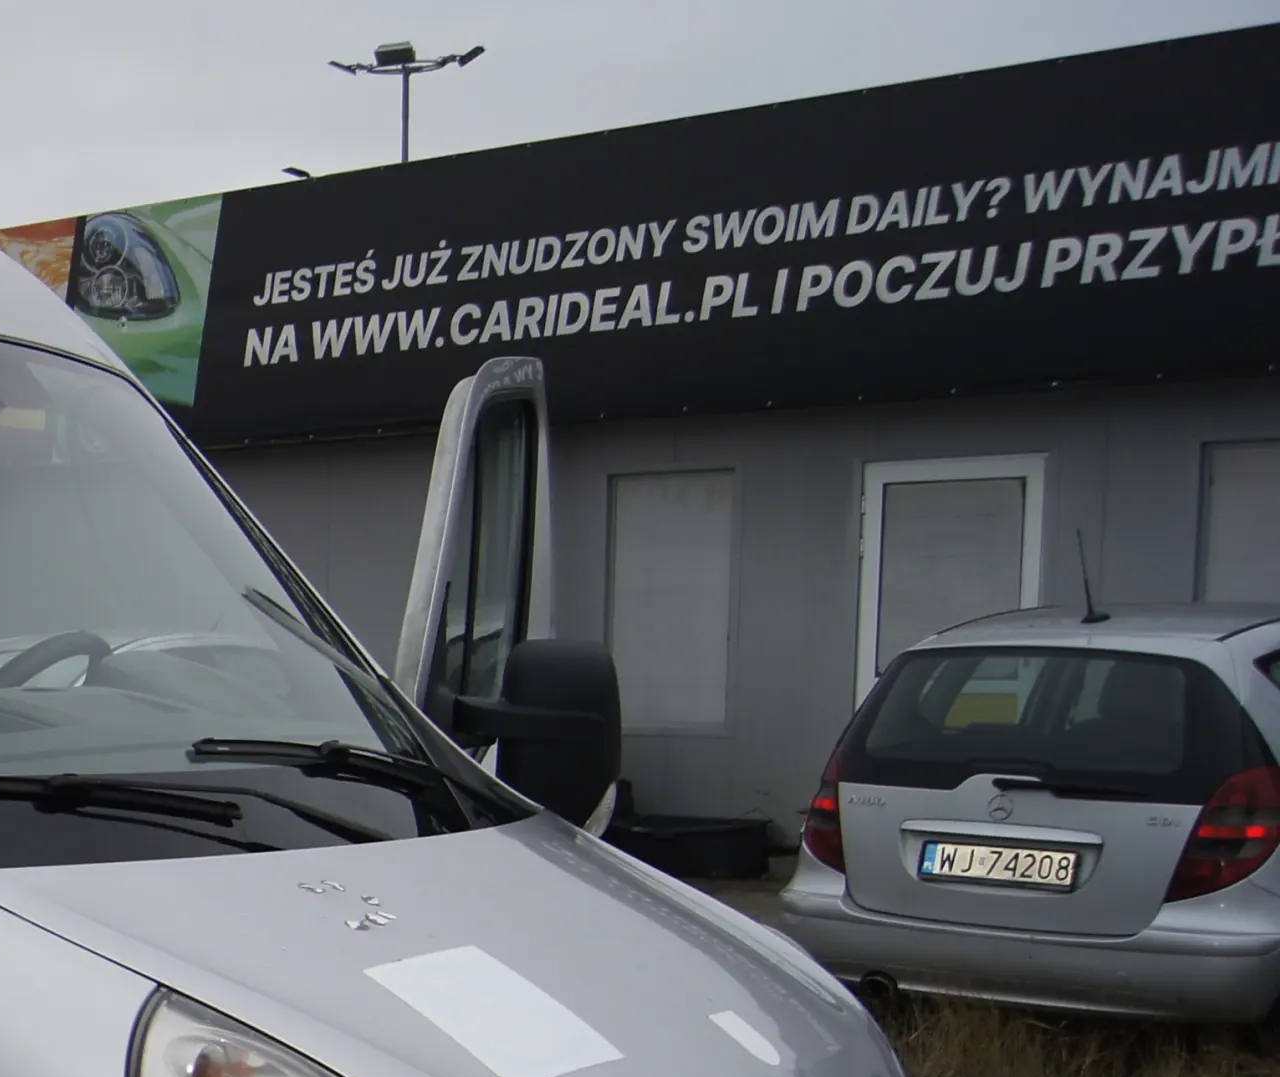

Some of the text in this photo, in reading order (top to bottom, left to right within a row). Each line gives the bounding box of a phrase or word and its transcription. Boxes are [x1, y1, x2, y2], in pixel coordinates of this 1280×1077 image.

[243, 323, 299, 367] NA
[312, 273, 758, 359] WWW.CARIDEAL.PL
[771, 268, 787, 315] I
[796, 241, 1032, 312] POCZUJ
[253, 250, 375, 306] JESTEŚ
[382, 240, 451, 290] JUŻ
[457, 219, 677, 281] ZNUDZONY
[682, 198, 841, 254] SWOIM
[846, 178, 1011, 236] DAILY?
[941, 847, 1071, 882] WJ 74208
